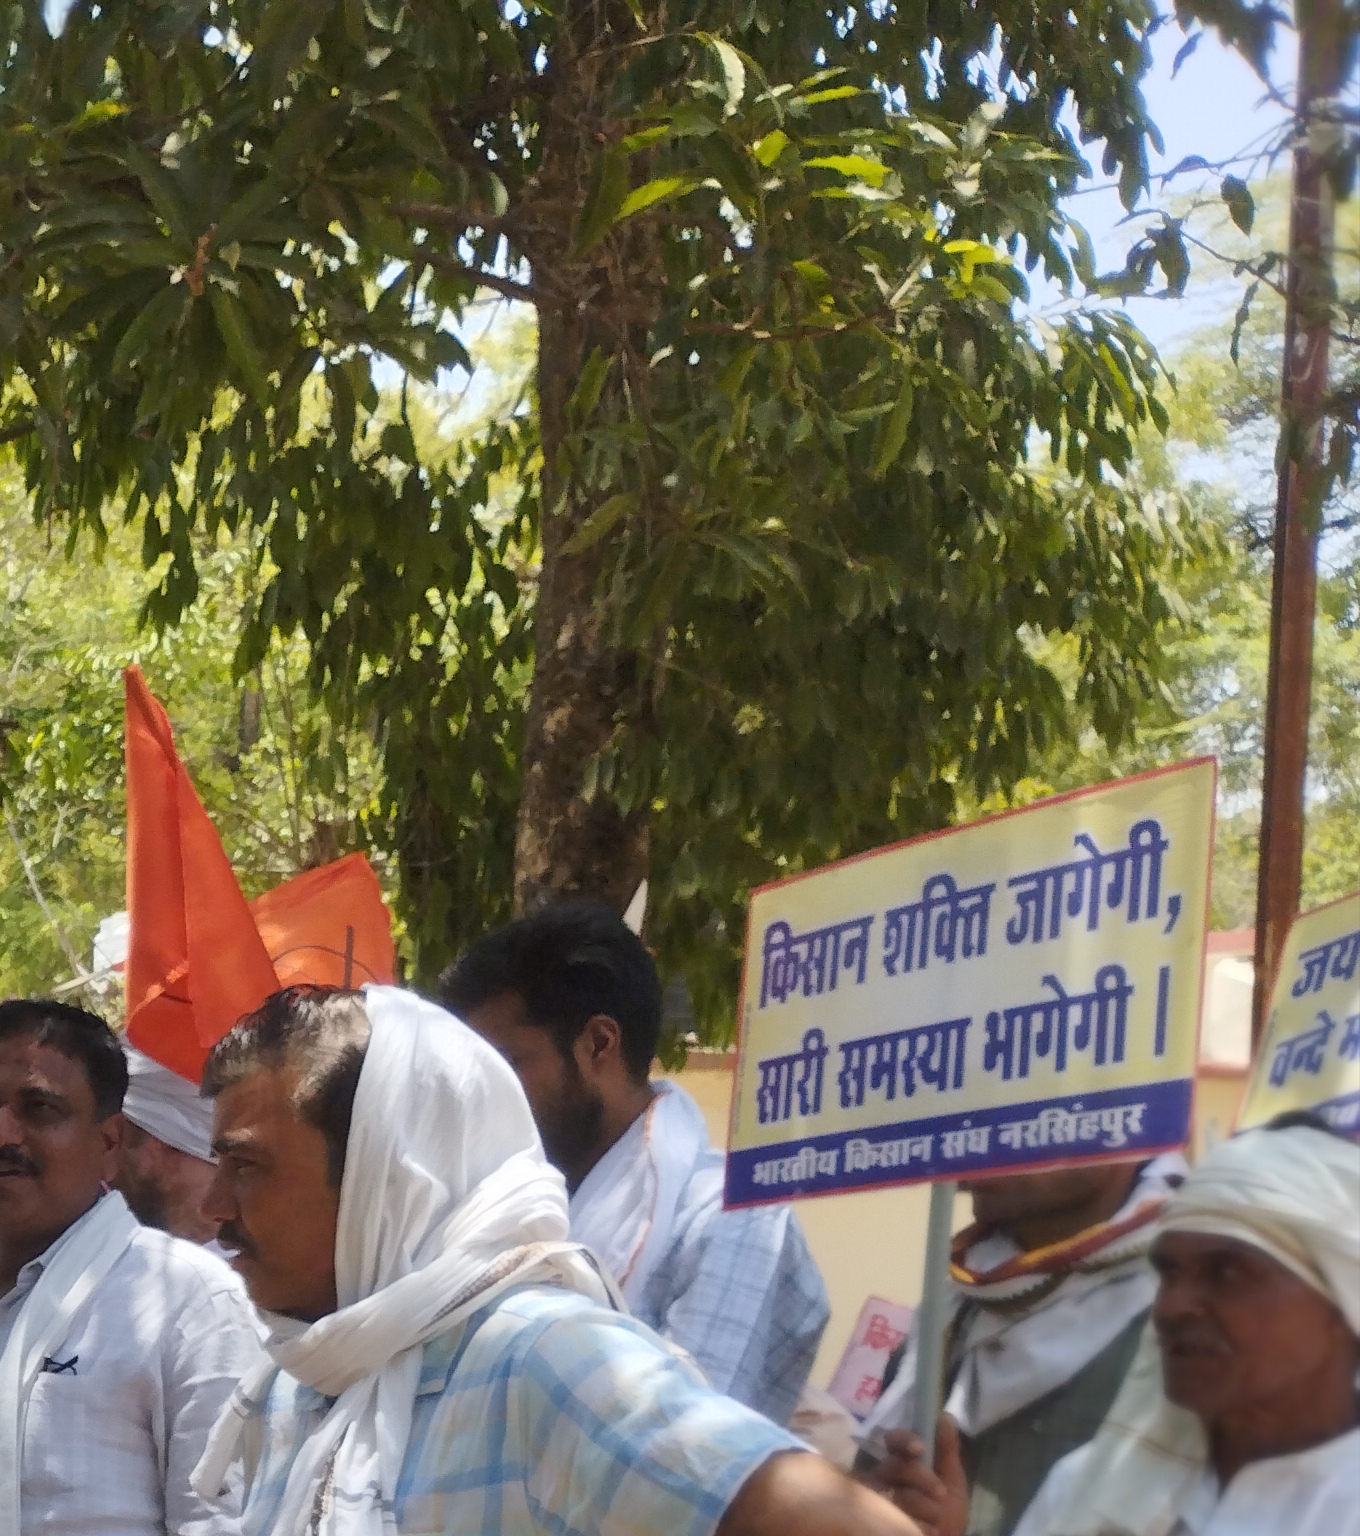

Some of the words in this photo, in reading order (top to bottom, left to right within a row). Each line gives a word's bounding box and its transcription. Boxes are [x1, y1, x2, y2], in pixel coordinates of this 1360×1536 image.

[760, 915, 876, 1010] किसान
[883, 873, 996, 976] शक्ति
[757, 1028, 829, 1124] सारी
[837, 1017, 973, 1108] समस्या
[752, 1147, 840, 1186] भारतीय
[844, 1136, 932, 1173] किसान
[941, 1119, 989, 1158] संघ
